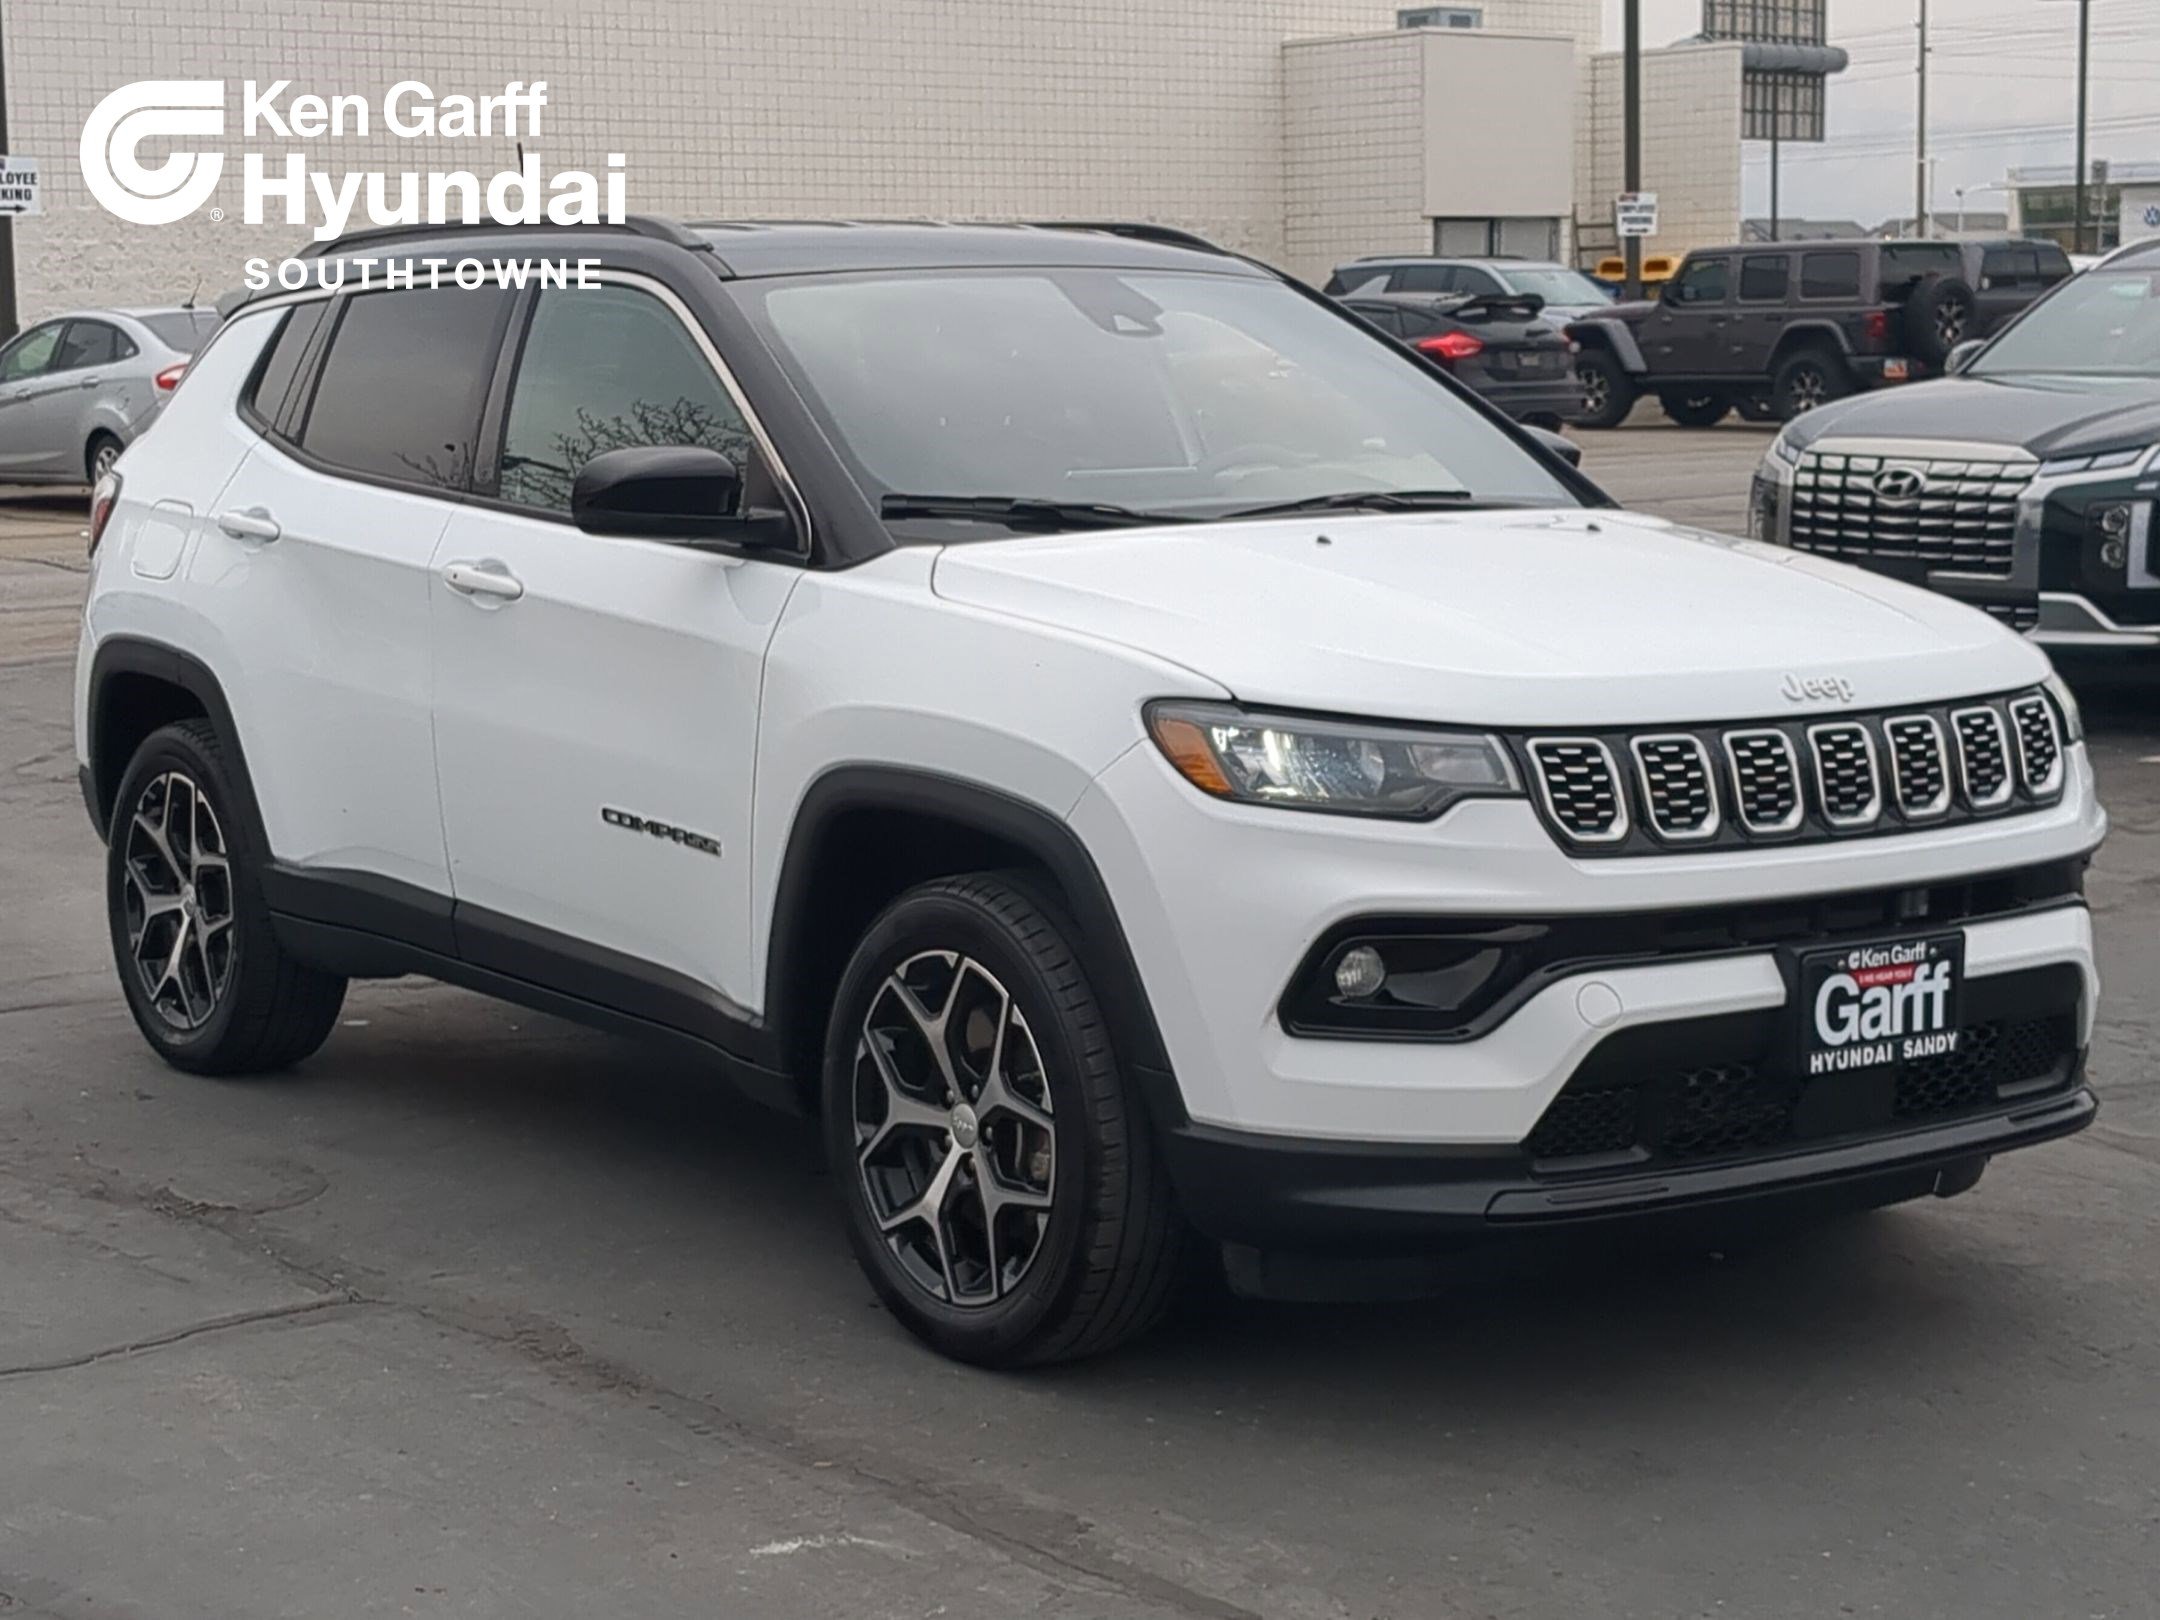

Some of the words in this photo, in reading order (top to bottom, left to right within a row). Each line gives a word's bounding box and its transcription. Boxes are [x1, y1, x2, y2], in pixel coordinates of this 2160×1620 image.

[1780, 673, 1854, 703] Jeep
[602, 806, 722, 857] COMPASS
[1862, 948, 1889, 969] Ken
[1891, 941, 1927, 964] Garff
[1815, 960, 1951, 1046] Garff
[1810, 1043, 1893, 1074] HYUNDAI
[1903, 1032, 1958, 1058] SANDY
